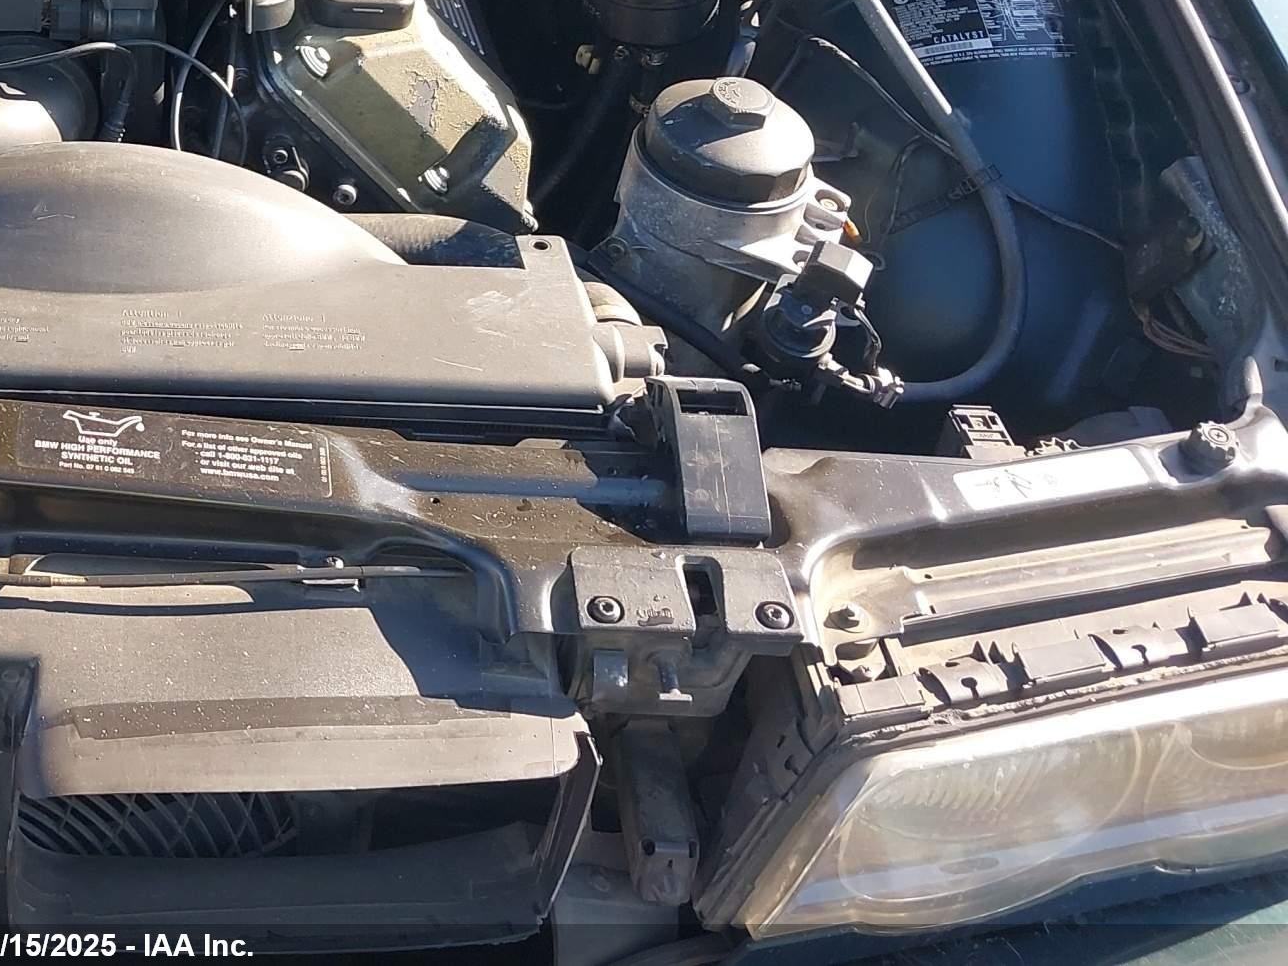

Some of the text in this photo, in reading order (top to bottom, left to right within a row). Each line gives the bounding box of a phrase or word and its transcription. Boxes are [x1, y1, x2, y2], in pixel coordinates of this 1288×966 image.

[933, 31, 985, 44] CATALYST
[78, 435, 118, 447] Use only
[181, 429, 313, 450] For more info see Owner's Manual
[34, 439, 161, 460] BMW HIGH PERFORMANCE
[181, 440, 195, 448] For
[203, 442, 216, 450] list
[227, 445, 249, 454] other
[249, 448, 287, 458] approved
[287, 451, 303, 460] oils
[199, 450, 215, 458] call
[59, 461, 73, 469] Part
[73, 462, 84, 470] No.
[61, 451, 133, 466] SYNTHETIC OIL
[199, 467, 280, 482] www.bmwusa.com
[211, 459, 230, 468] visit
[231, 462, 246, 470] our
[247, 462, 267, 472] web
[268, 465, 285, 474] site
[285, 467, 295, 475] at
